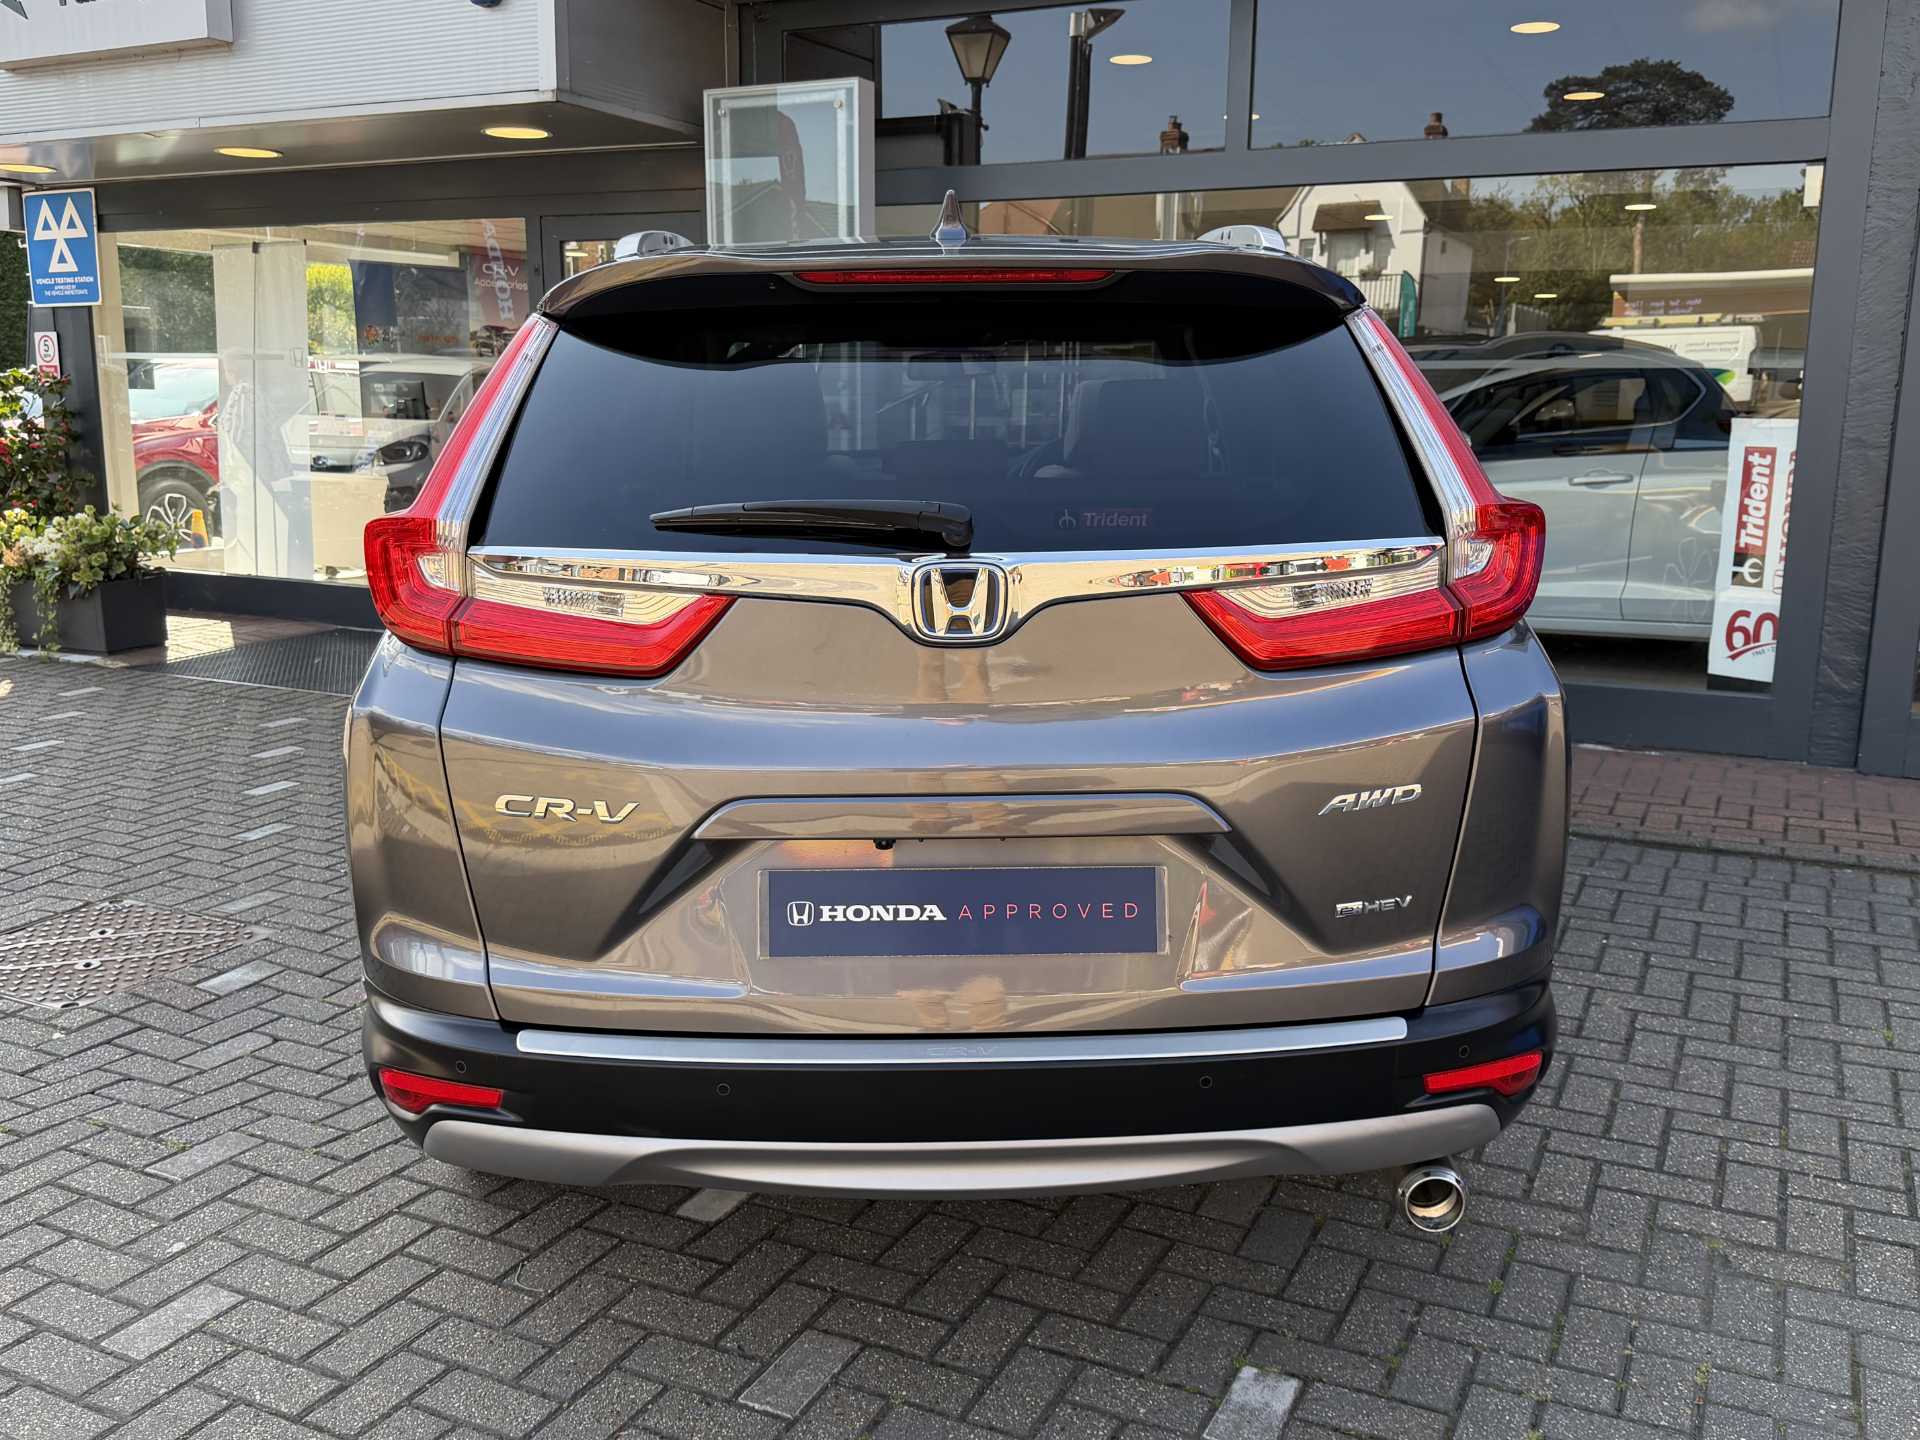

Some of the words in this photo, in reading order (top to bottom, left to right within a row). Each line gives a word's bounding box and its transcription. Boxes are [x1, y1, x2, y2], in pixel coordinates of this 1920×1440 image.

[35, 277, 55, 285] VEHICLE
[55, 276, 74, 284] TESTING
[74, 275, 94, 283] STATION
[43, 339, 50, 353] 5
[1739, 451, 1772, 549] Trident
[1083, 511, 1148, 528] Trident
[1726, 609, 1778, 653] 60
[495, 794, 640, 824] CR-V
[1318, 783, 1422, 816] AWD
[819, 904, 947, 922] HONDA
[958, 903, 1139, 920] APPROVED
[927, 1046, 1000, 1057] CR-V
